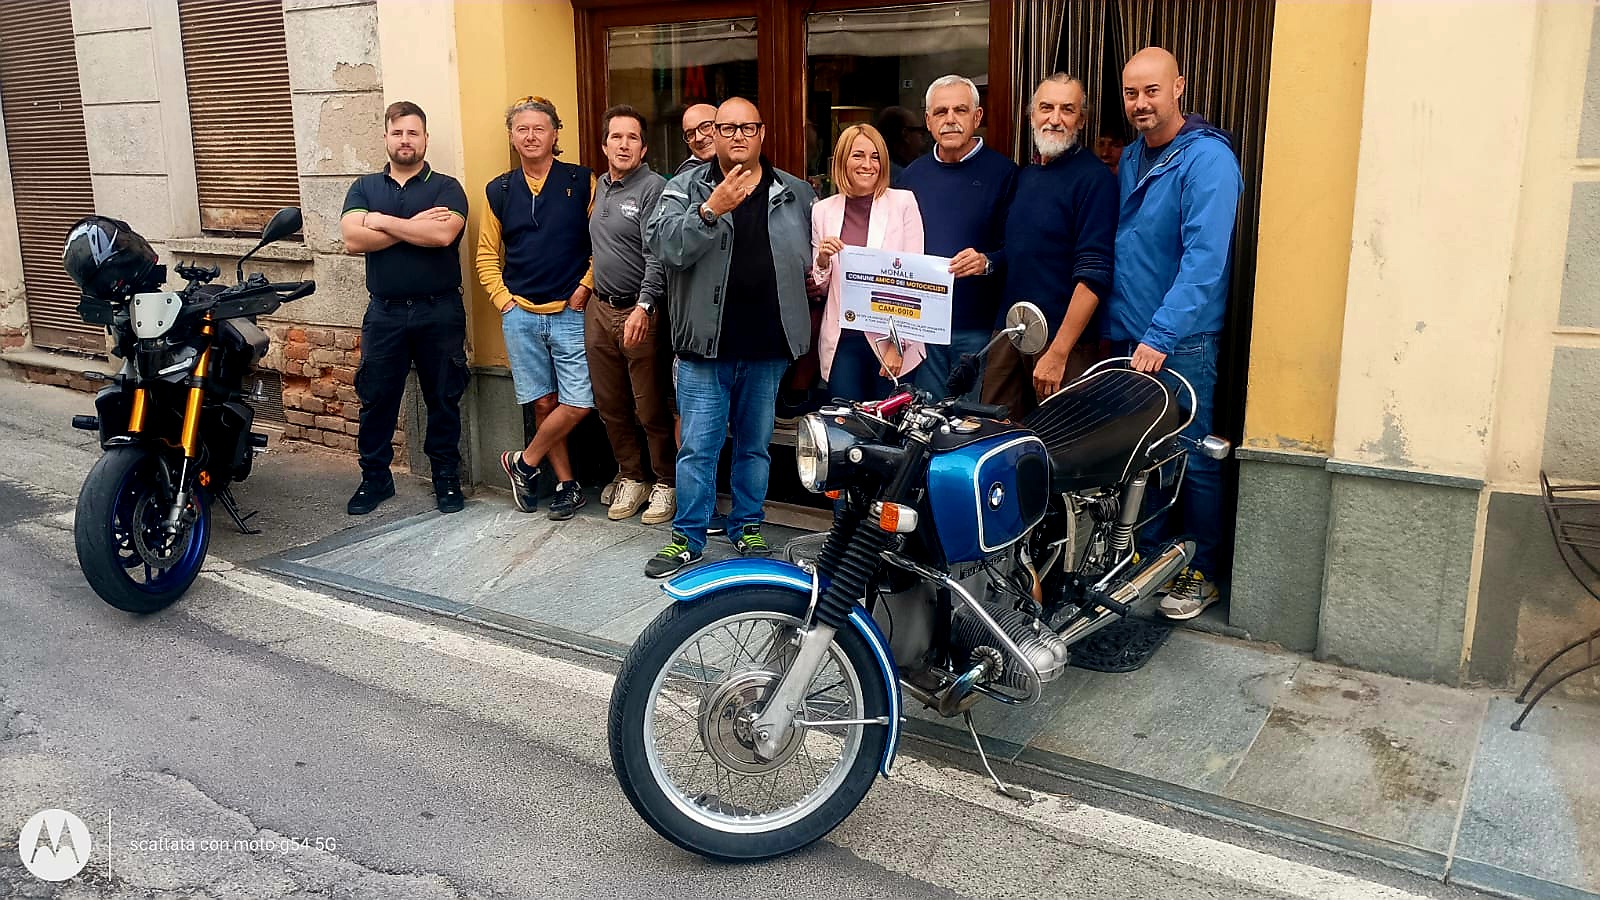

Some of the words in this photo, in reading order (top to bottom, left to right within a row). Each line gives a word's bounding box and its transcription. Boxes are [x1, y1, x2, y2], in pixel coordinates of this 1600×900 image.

[880, 268, 914, 279] MONALE
[848, 273, 875, 282] COMUNE
[875, 276, 896, 285] AMICO
[906, 281, 946, 293] MOTOCICLISTI
